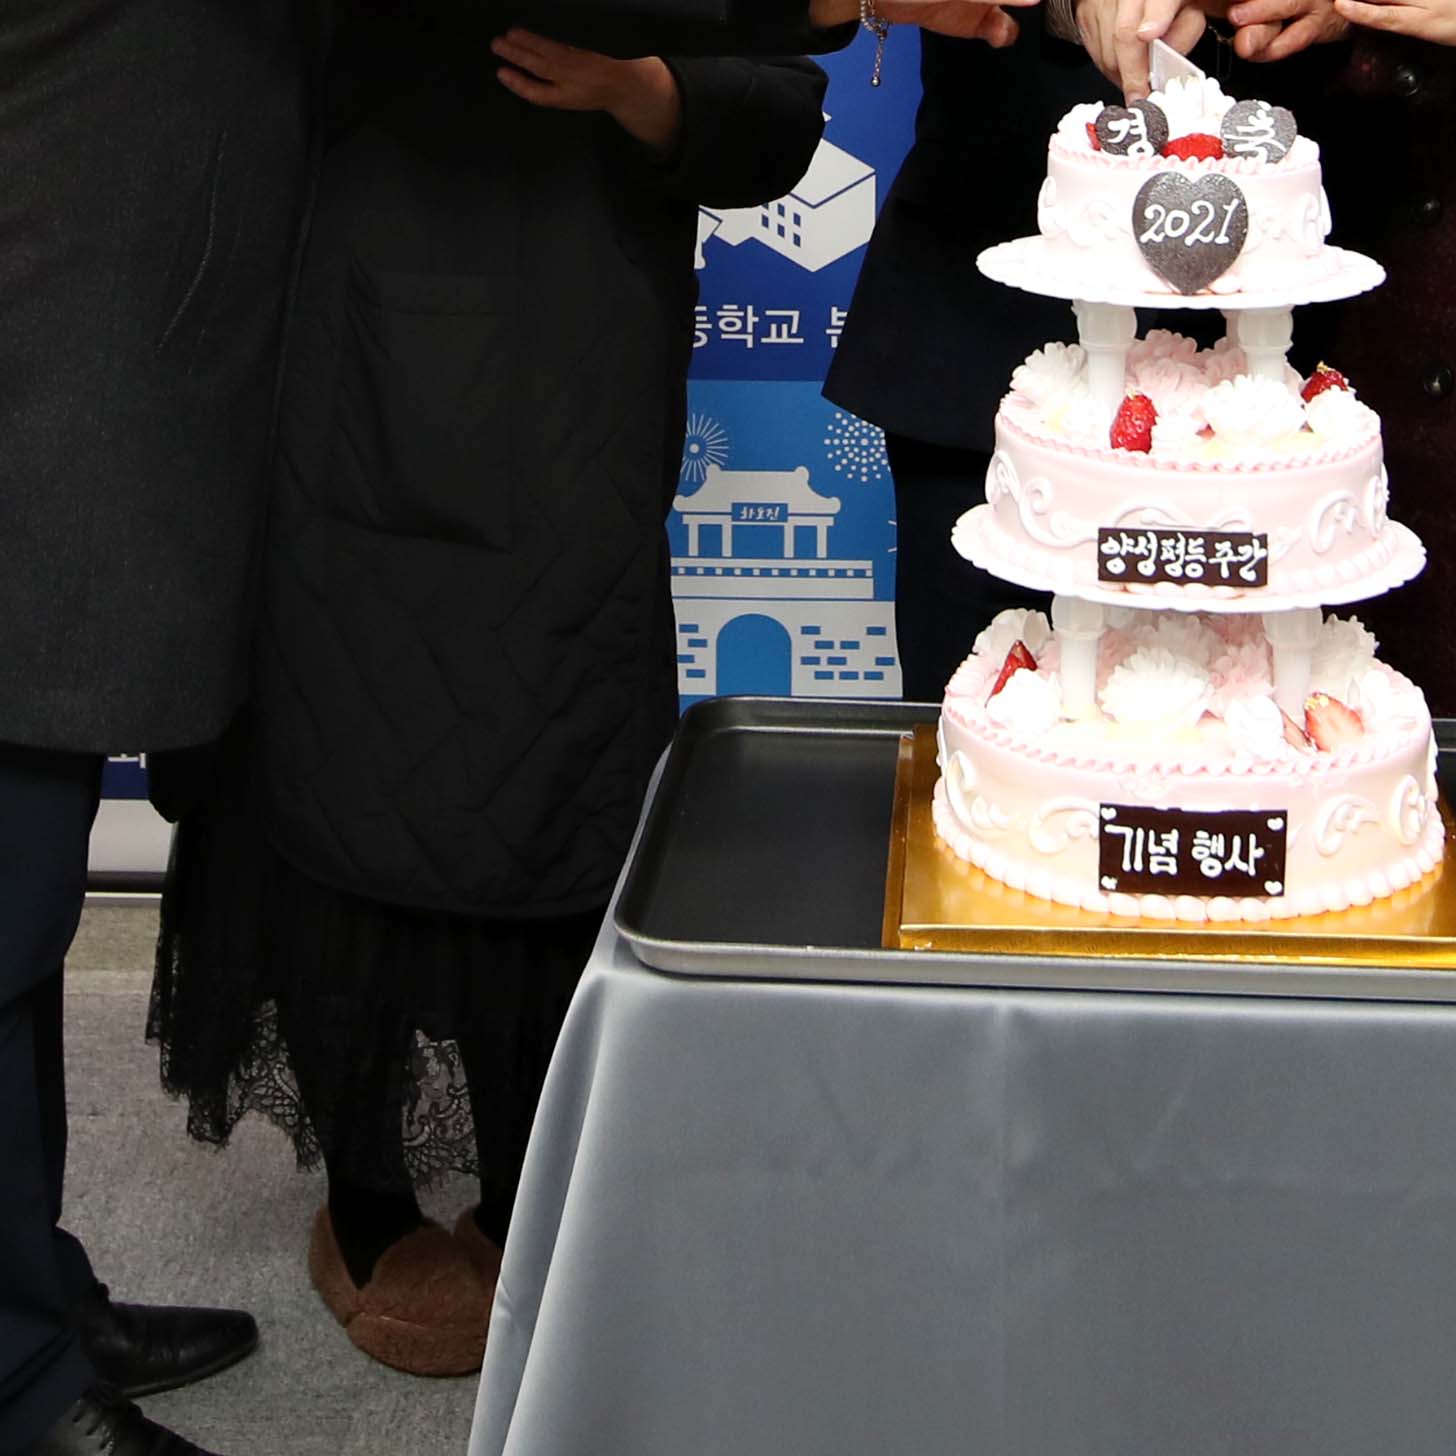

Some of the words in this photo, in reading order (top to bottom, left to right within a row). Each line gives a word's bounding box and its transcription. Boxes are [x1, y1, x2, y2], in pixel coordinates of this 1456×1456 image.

[1139, 197, 1241, 246] 2021
[1100, 530, 1206, 579] 양성평등
[1208, 537, 1269, 582] 주간
[1103, 823, 1180, 876] 기념
[1191, 829, 1266, 879] 행사
